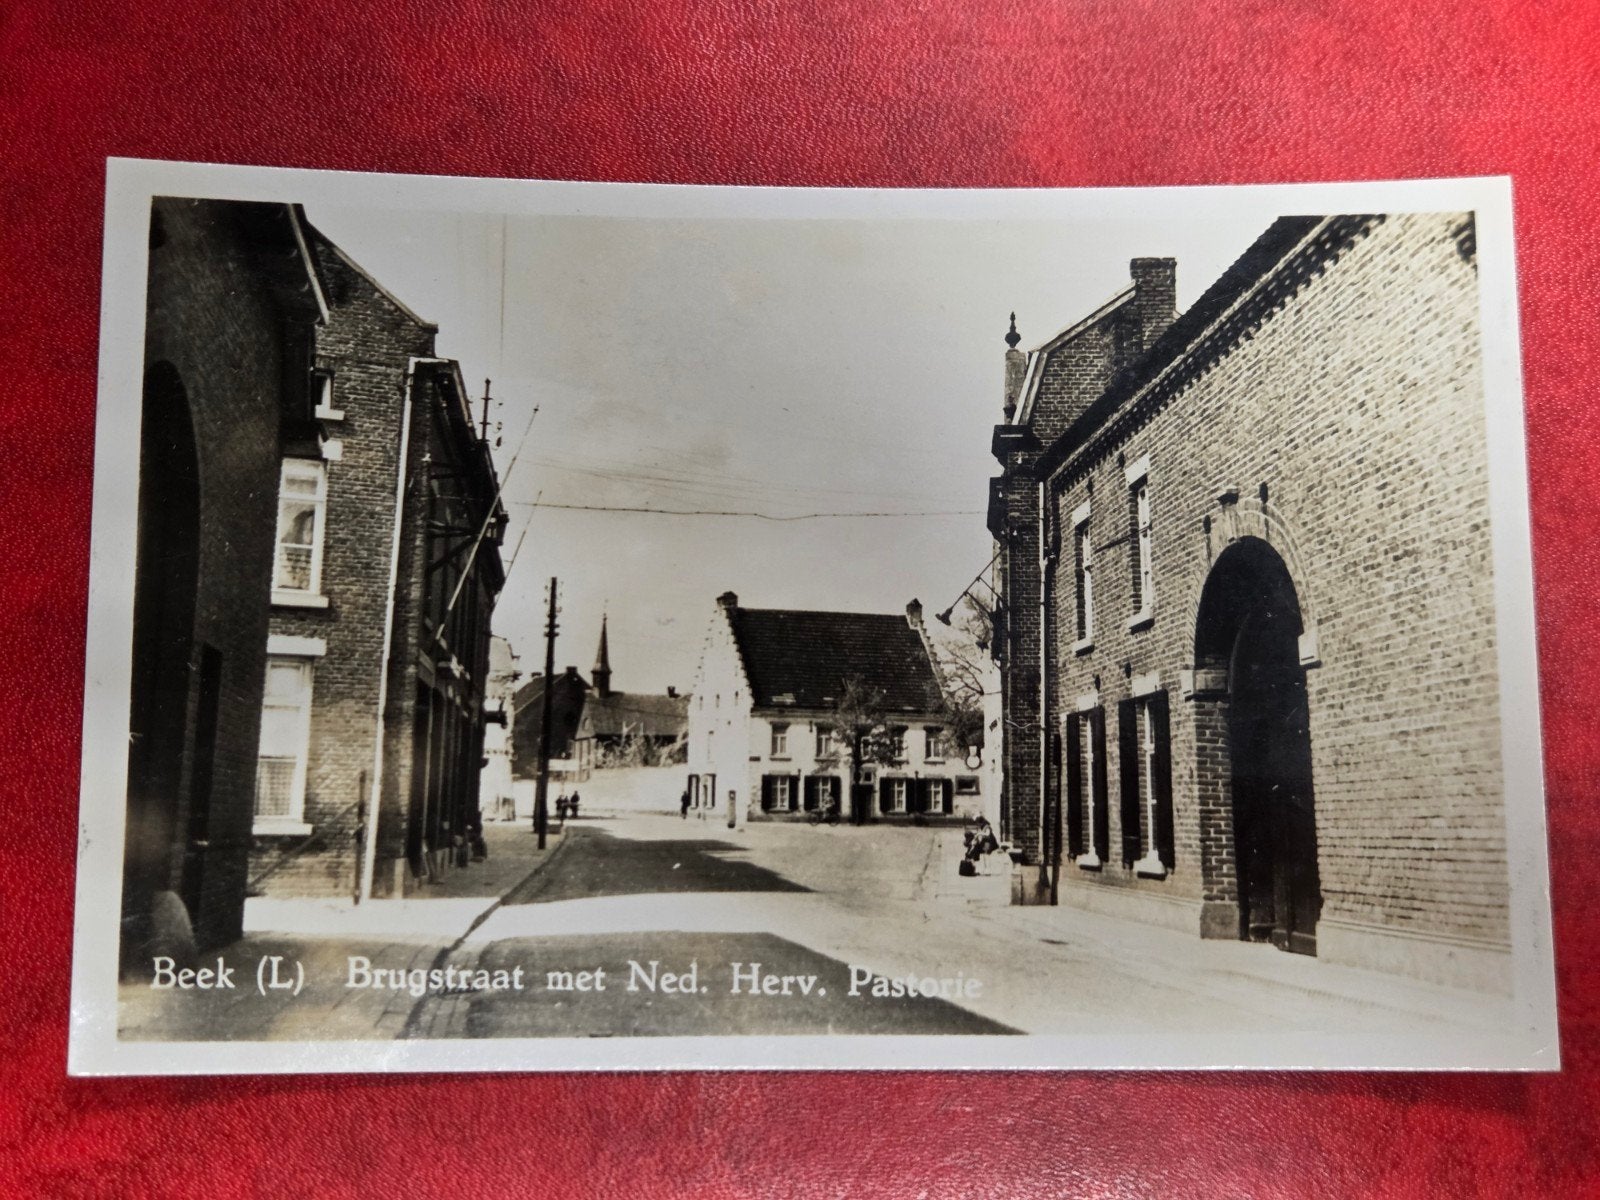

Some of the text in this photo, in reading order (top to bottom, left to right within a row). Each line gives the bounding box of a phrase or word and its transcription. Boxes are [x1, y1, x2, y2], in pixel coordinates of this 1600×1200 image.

[150, 955, 983, 998] Beek (L) Brugstraat met Ned. Herv. Pastorie
